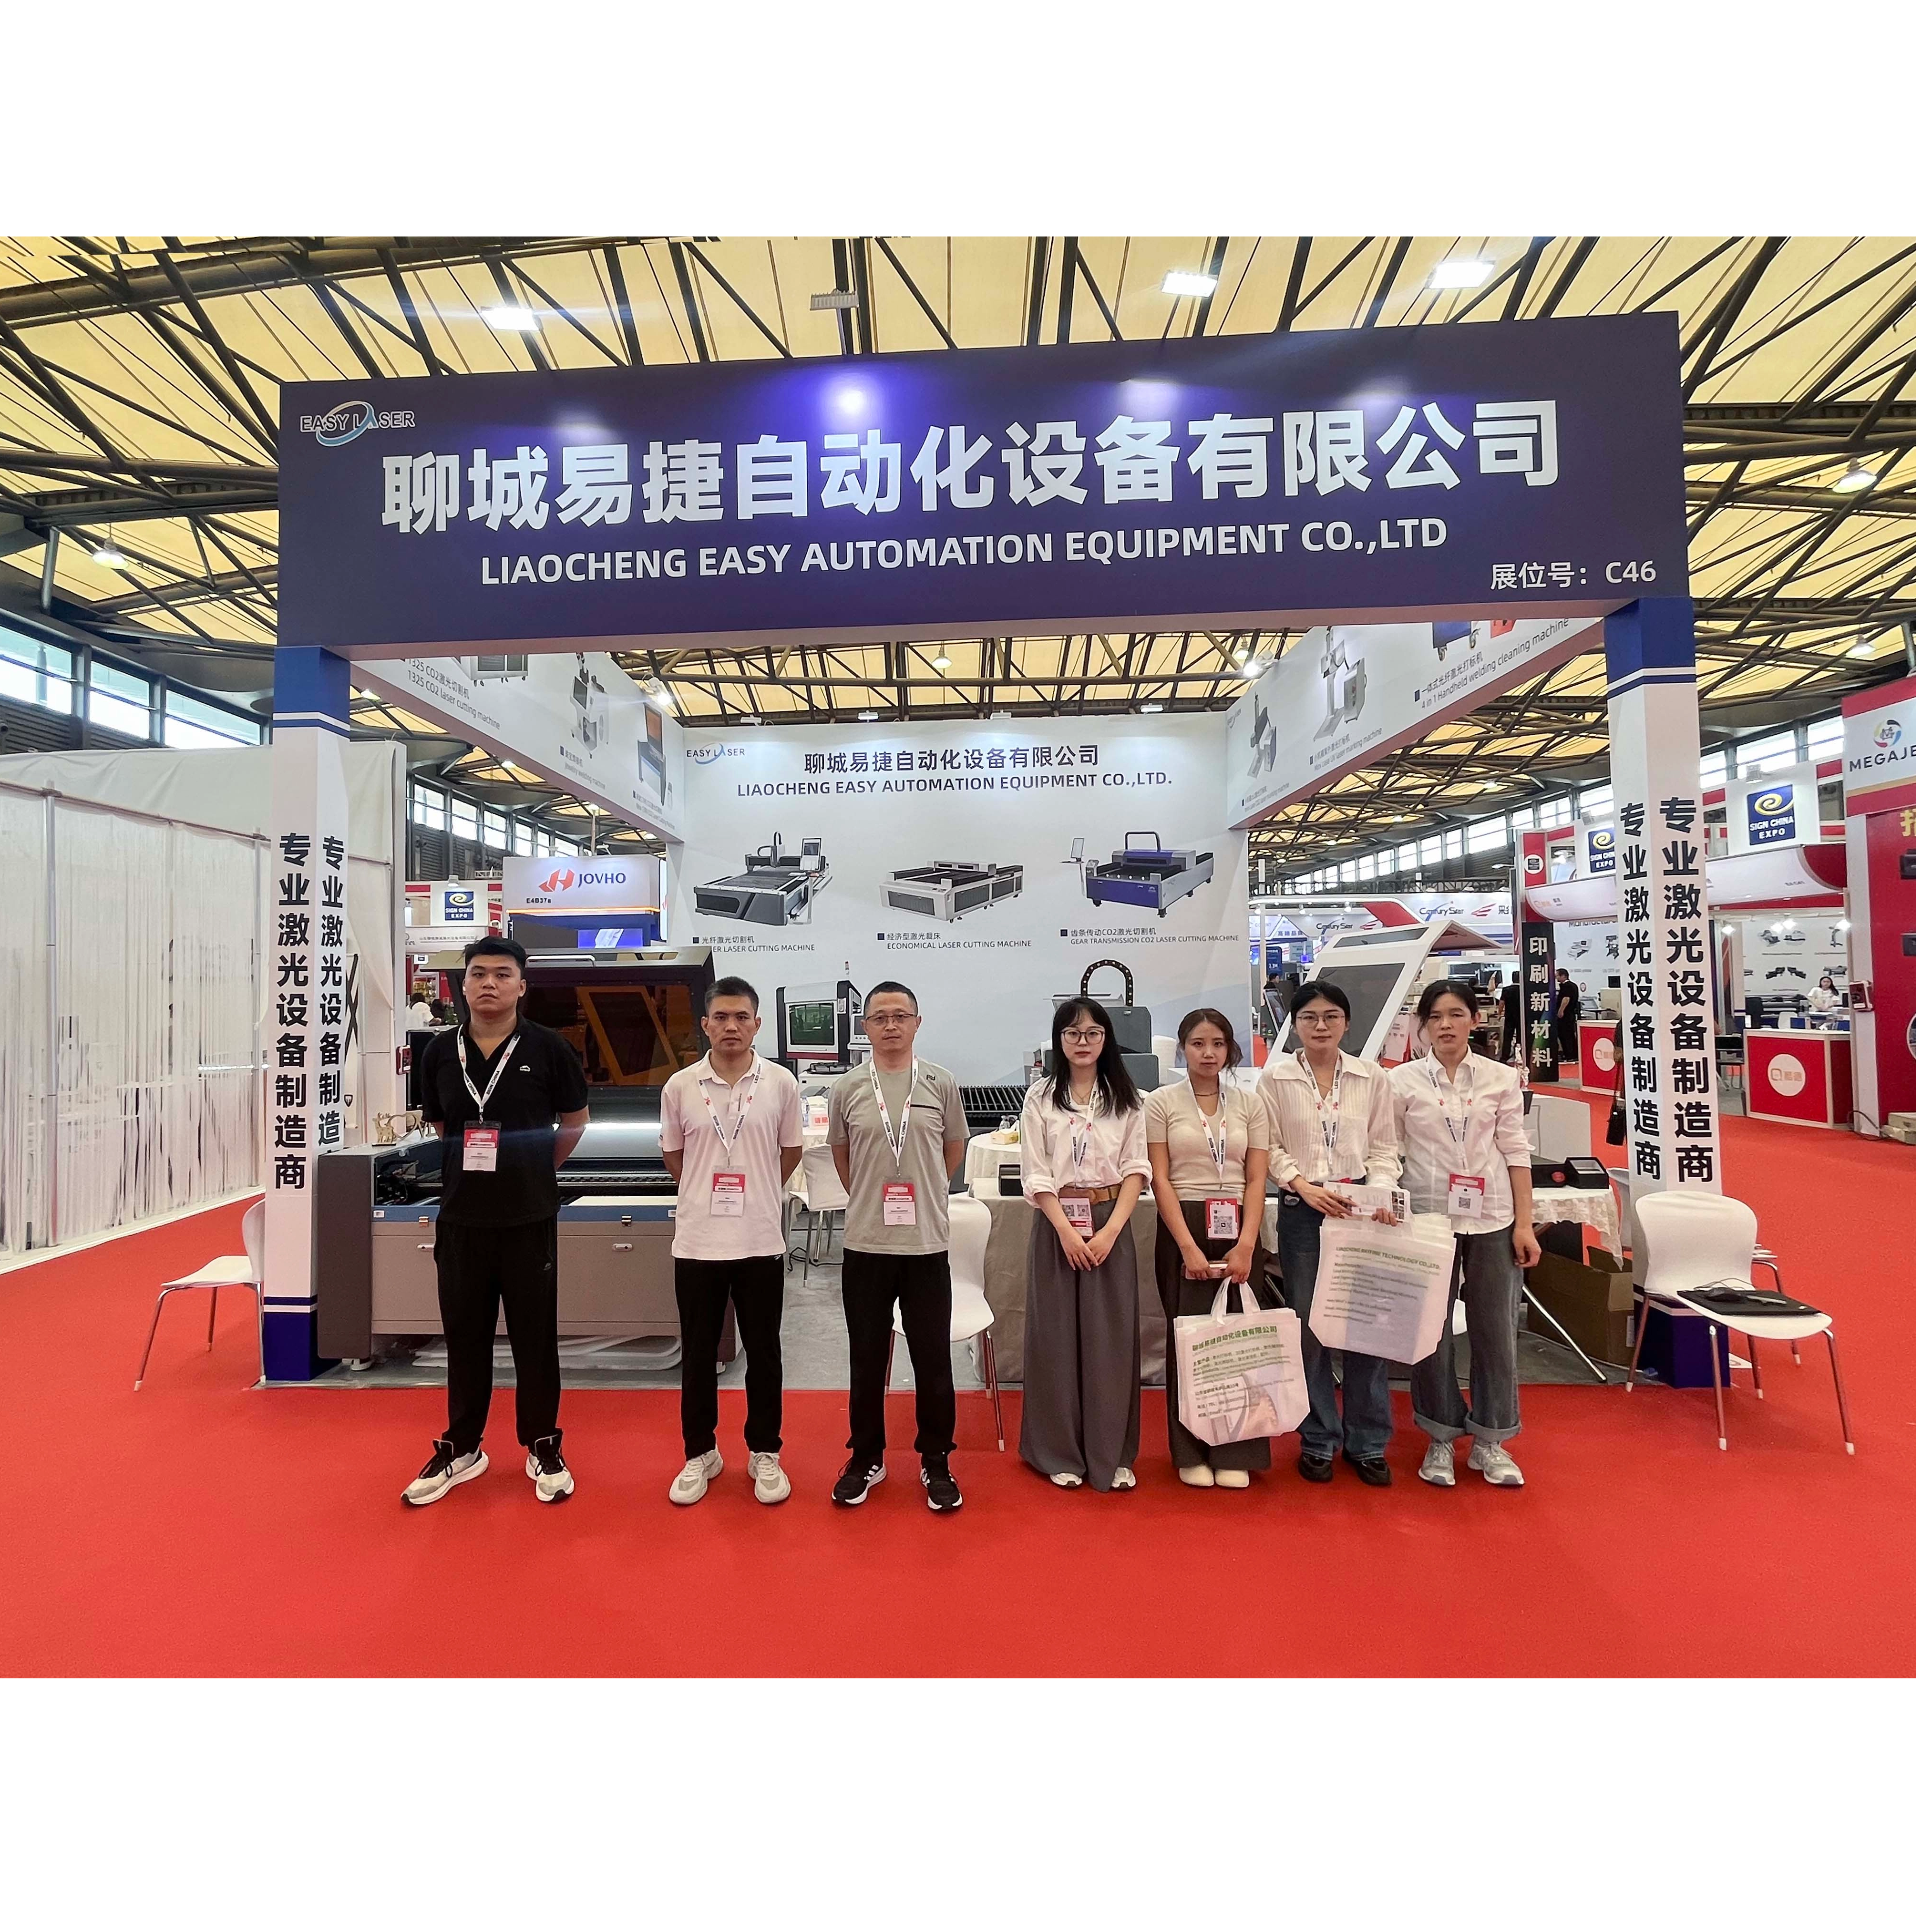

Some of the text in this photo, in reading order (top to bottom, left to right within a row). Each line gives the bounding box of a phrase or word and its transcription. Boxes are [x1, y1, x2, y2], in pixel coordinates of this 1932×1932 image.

[300, 413, 349, 432] EASY
[381, 399, 1559, 535] 聊城易捷自动化设备有限公司
[482, 518, 1447, 586] LIAOCHENG EASY AUTOMATION EQUIPMENT CO.,LTD
[1604, 560, 1657, 584] C46
[1438, 675, 1468, 700] Handheld
[1469, 661, 1496, 682] welding
[1498, 640, 1531, 666] cleaning
[1532, 618, 1569, 646] machine
[408, 670, 500, 730] 1325 CO2 laser cutting machine
[687, 749, 711, 758] EASY
[804, 745, 1098, 773] 聊城易捷自动化设备有限公司
[1849, 745, 1916, 772] MEGAJE
[738, 772, 1172, 796] LIAOCHENG EASY AUTOMATION EQUIPMENT CO.,LTD.
[1749, 816, 1794, 831] SIGN CHINA
[1758, 828, 1786, 839] EXPO
[578, 873, 626, 888] JOVHO
[1070, 927, 1156, 937] 齿条传动CO2激光切割机
[887, 942, 937, 950] ECONOMICAL
[319, 835, 344, 1151] 专业激光设备制造
[1529, 936, 1552, 1068] 印刷新材料
[1620, 803, 1661, 1180] 专业激光设备制造商
[1659, 797, 1714, 1182] 专业激光设备制造商
[274, 832, 311, 1189] 专业激光设备制造商
